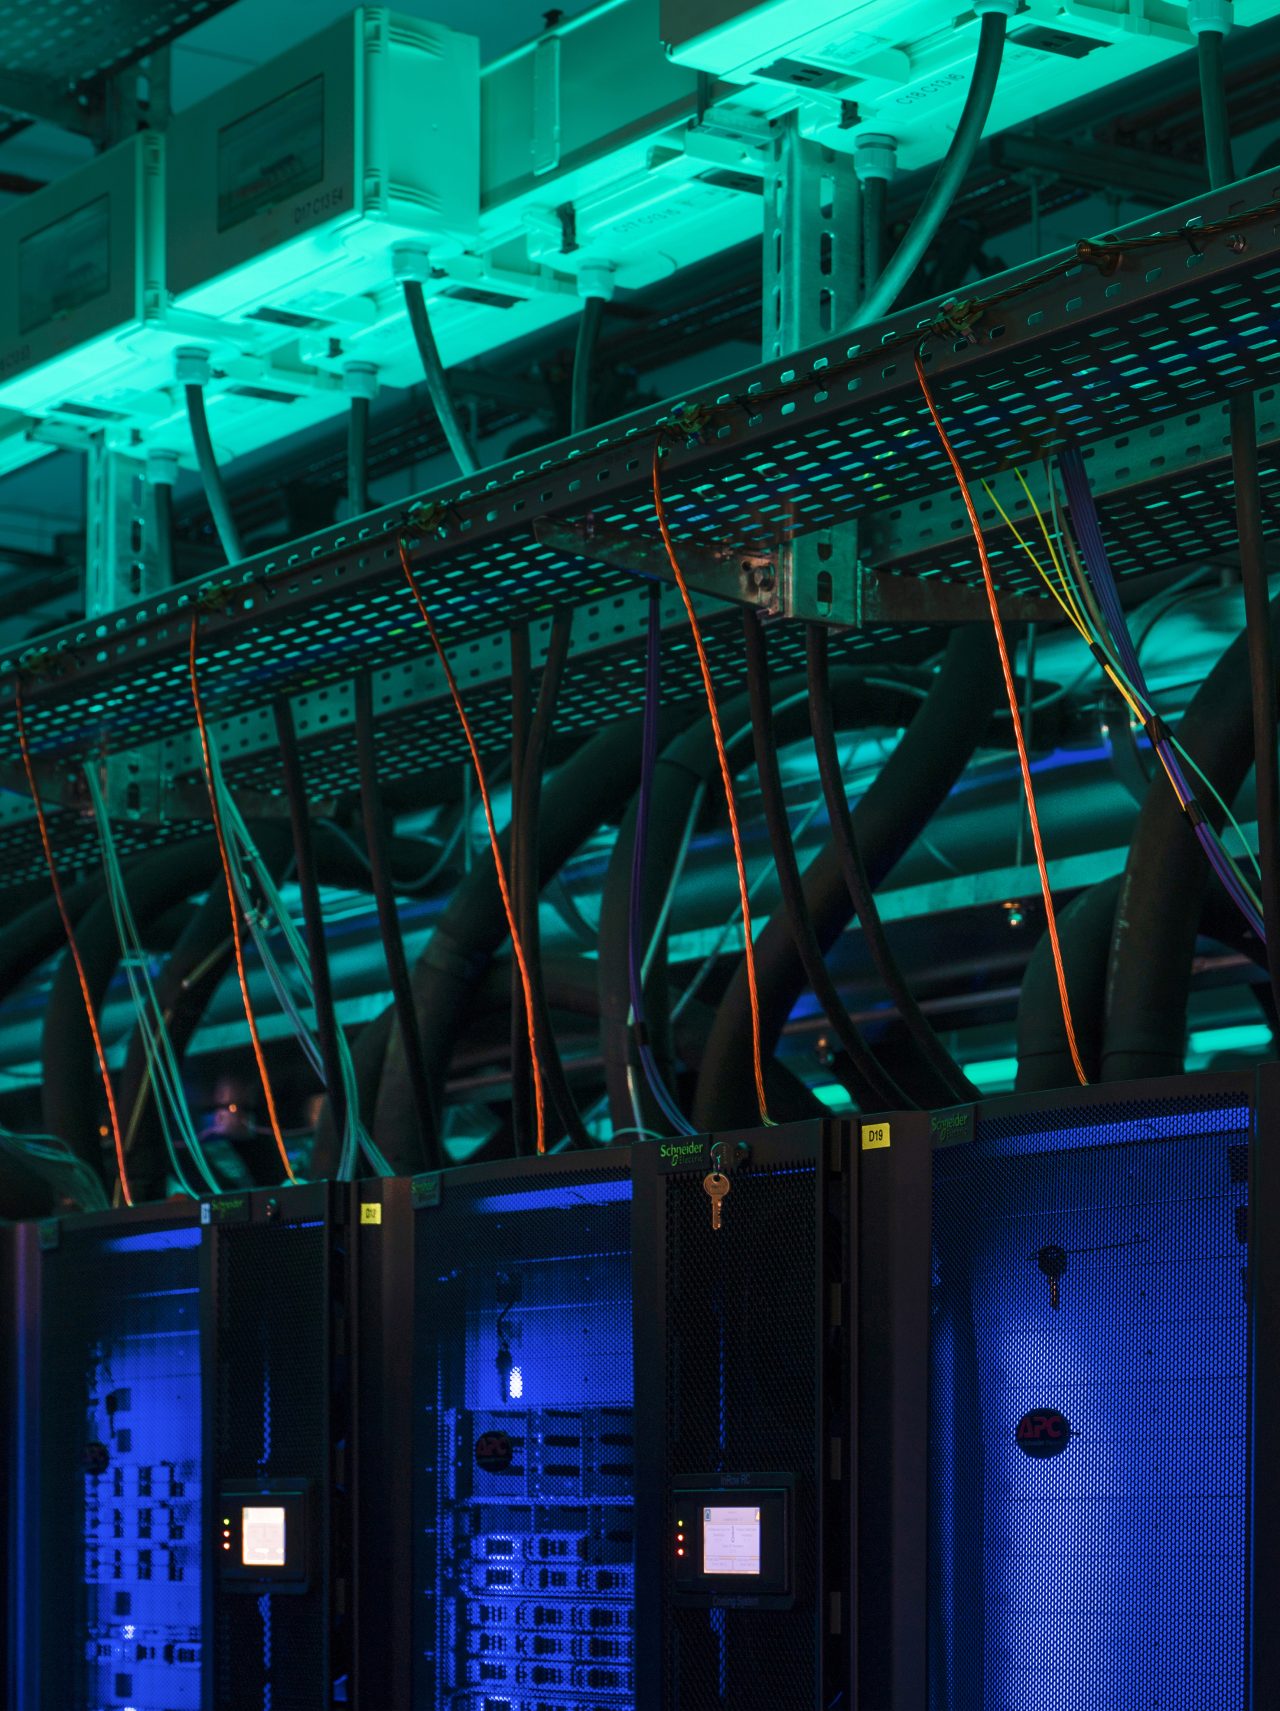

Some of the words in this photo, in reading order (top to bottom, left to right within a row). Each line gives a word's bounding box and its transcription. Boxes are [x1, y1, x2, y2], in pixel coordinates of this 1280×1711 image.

[868, 1129, 883, 1142] D19
[660, 1141, 704, 1157] Schneider
[1017, 1415, 1063, 1440] APC
